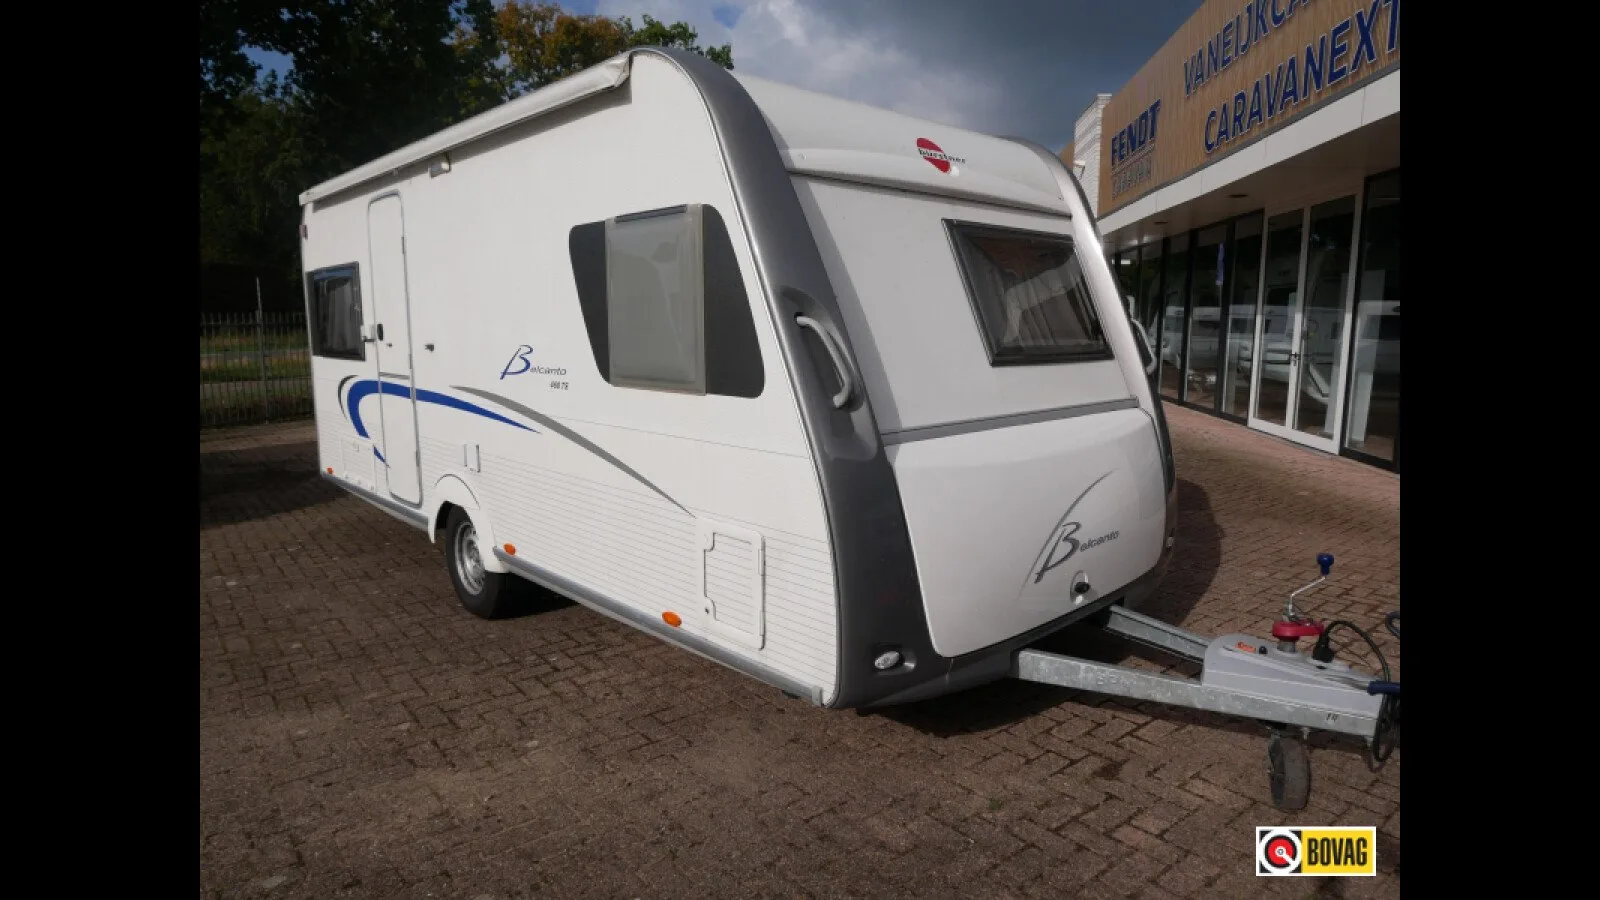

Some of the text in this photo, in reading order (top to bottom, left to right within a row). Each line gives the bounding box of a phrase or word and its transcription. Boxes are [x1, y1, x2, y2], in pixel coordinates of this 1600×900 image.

[1111, 98, 1161, 166] FENDT
[500, 345, 567, 380] Belcanto
[1034, 521, 1120, 584] Belcanto
